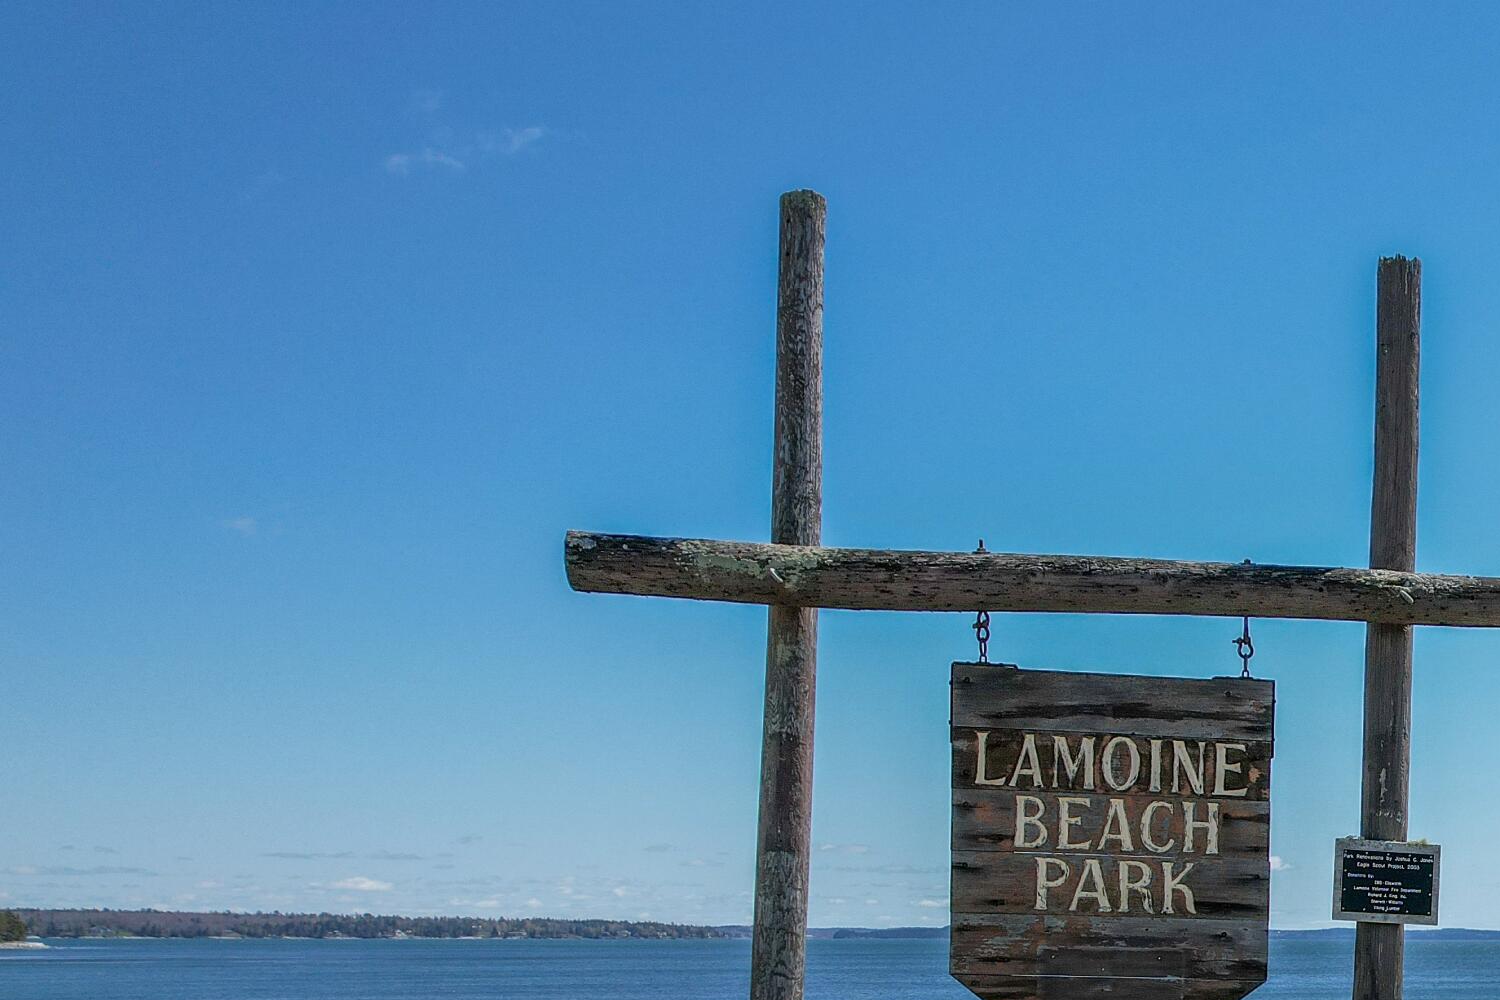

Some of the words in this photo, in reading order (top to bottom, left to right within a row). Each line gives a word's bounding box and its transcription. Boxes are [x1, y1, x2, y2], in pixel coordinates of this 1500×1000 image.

[974, 730, 1249, 797] LAMOINE
[1013, 795, 1220, 855] BEACH
[1033, 856, 1197, 915] PARK
